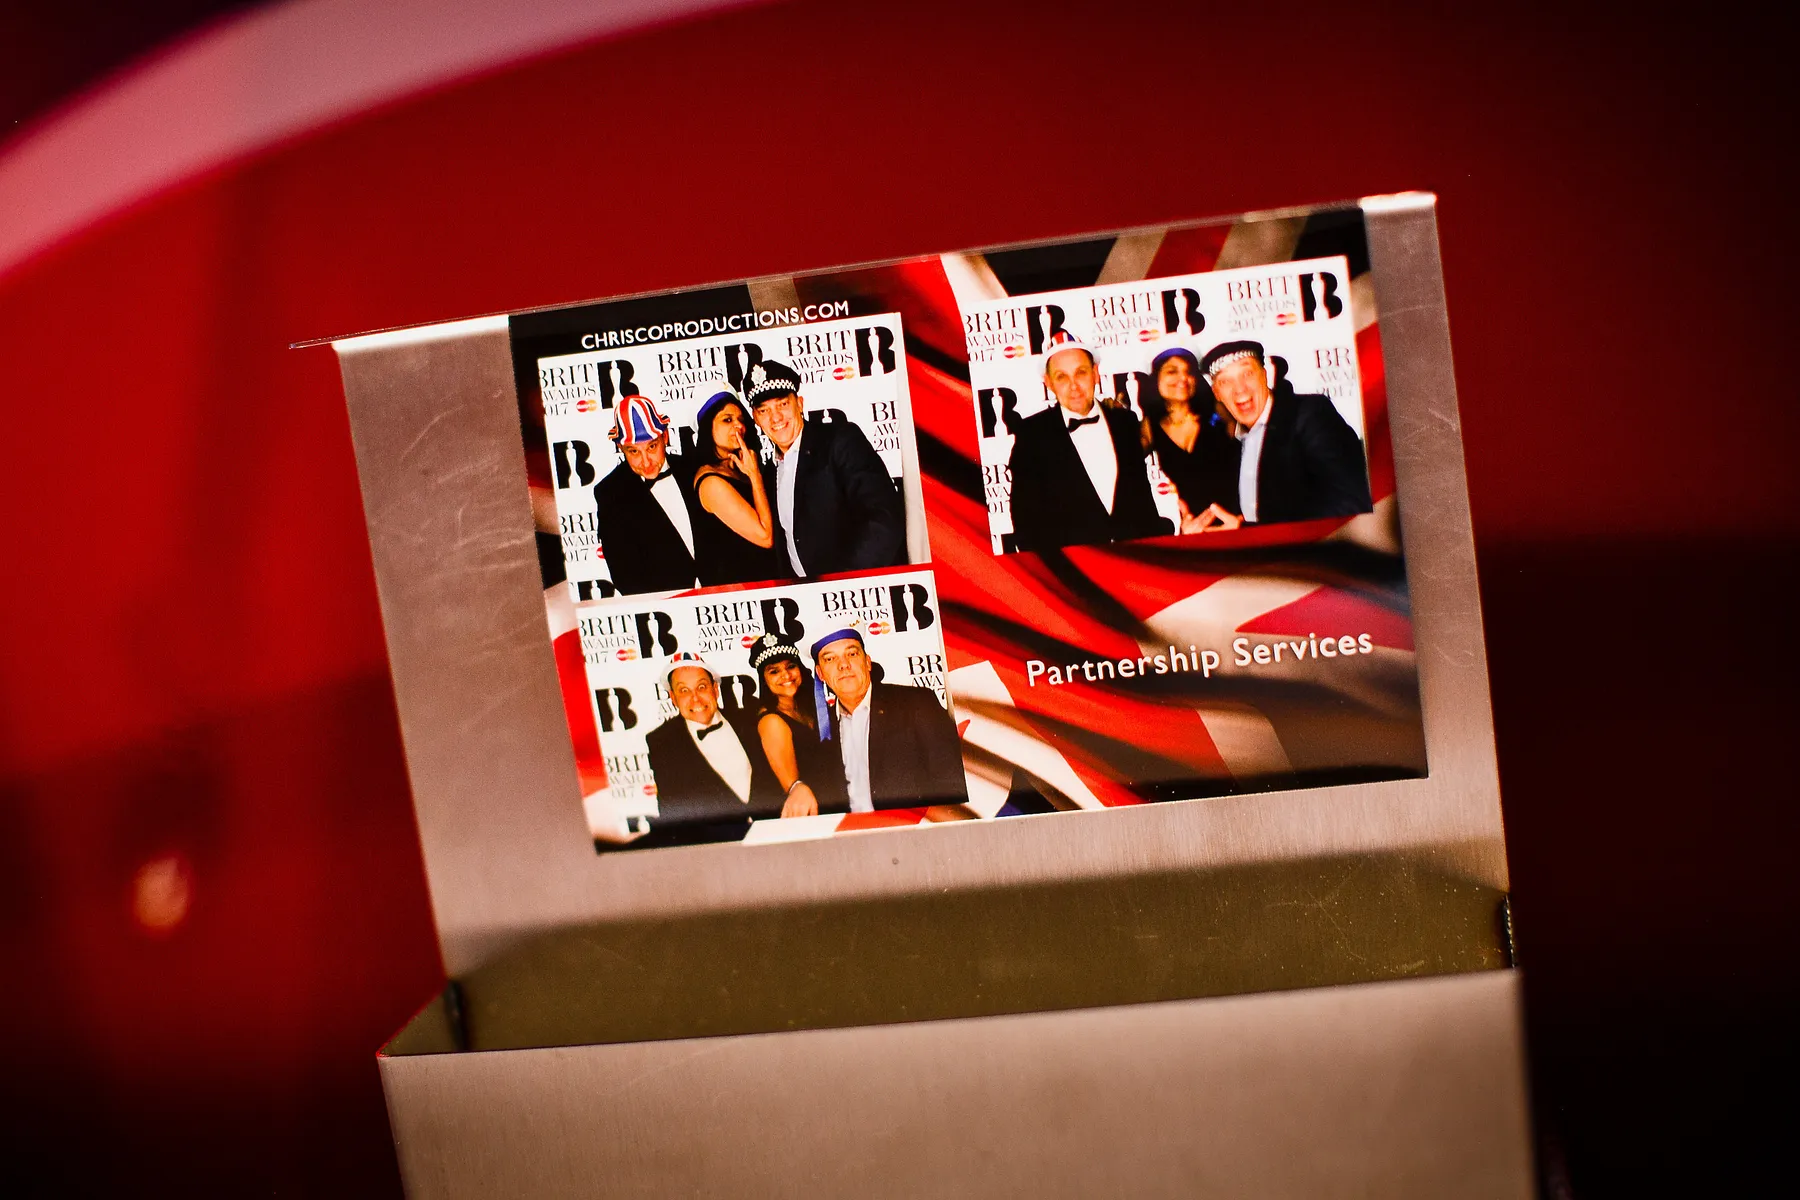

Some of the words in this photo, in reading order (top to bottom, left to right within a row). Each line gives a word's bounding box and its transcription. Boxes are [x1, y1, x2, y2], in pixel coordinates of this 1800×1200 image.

[1227, 275, 1293, 302] BRIT
[1091, 291, 1157, 318] BRIT
[1229, 299, 1297, 318] AWARDS
[581, 300, 850, 350] CHRISCOPRODUCTIONS.COM
[1093, 315, 1159, 334] AWARDS
[1229, 315, 1266, 333] 2017
[786, 329, 851, 357] BRIT
[968, 332, 1025, 348] WARDS
[1093, 331, 1130, 349] 2017
[658, 346, 722, 373] BRIT
[789, 351, 854, 371] AWARDS
[969, 348, 996, 363] 017
[660, 368, 724, 388] AWARDS
[799, 369, 825, 386] 017
[543, 384, 596, 403] WARDS
[661, 385, 696, 403] 2017
[544, 401, 569, 417] 017
[566, 548, 589, 563] 017
[821, 586, 886, 612] BRIT
[694, 600, 757, 626] BRIT
[698, 621, 761, 639] AWARDS
[583, 635, 636, 650] WARDS
[698, 637, 734, 654] 2017
[585, 650, 609, 665] 017
[1026, 645, 1221, 687] Partnership
[1232, 632, 1373, 667] Services
